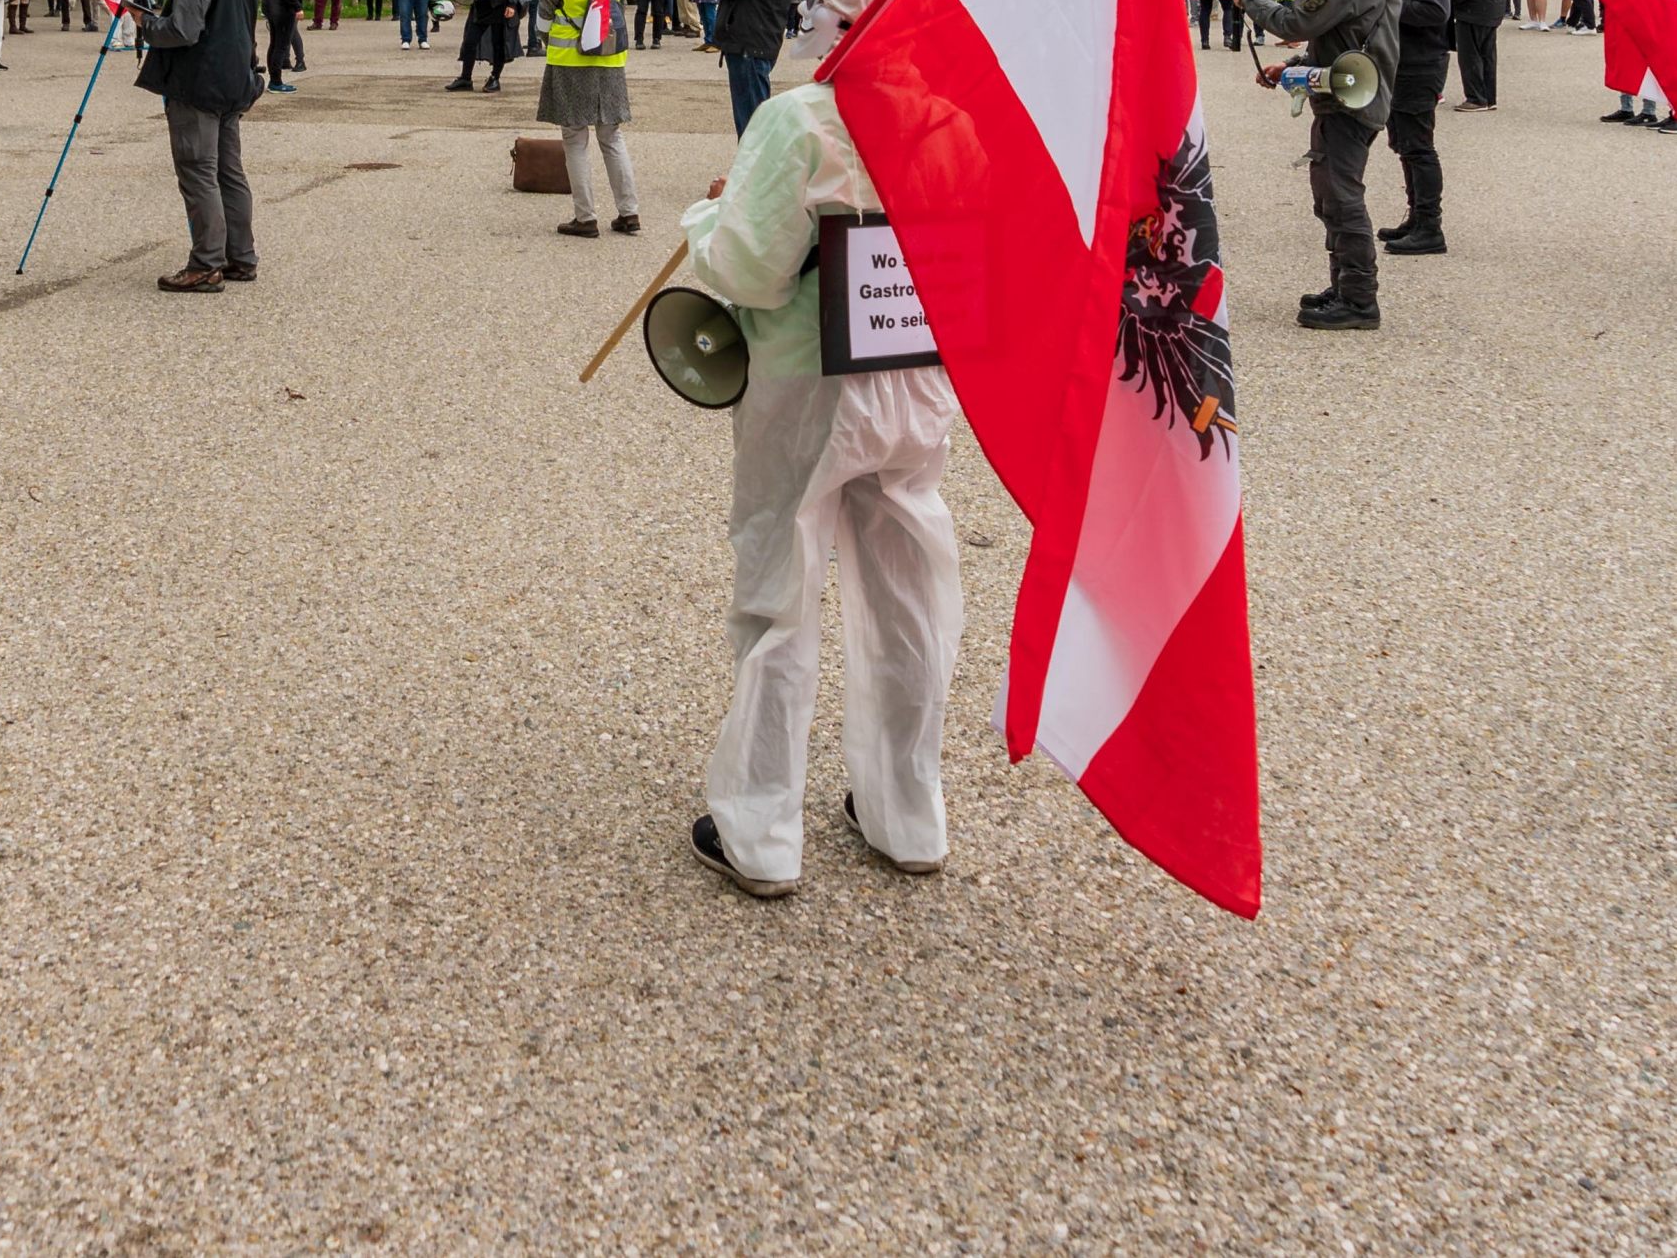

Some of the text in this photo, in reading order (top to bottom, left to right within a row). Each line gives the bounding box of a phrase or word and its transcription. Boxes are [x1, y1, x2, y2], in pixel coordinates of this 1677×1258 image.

[871, 254, 897, 269] Wo
[859, 283, 918, 299] Gastro
[869, 314, 896, 330] Wo
